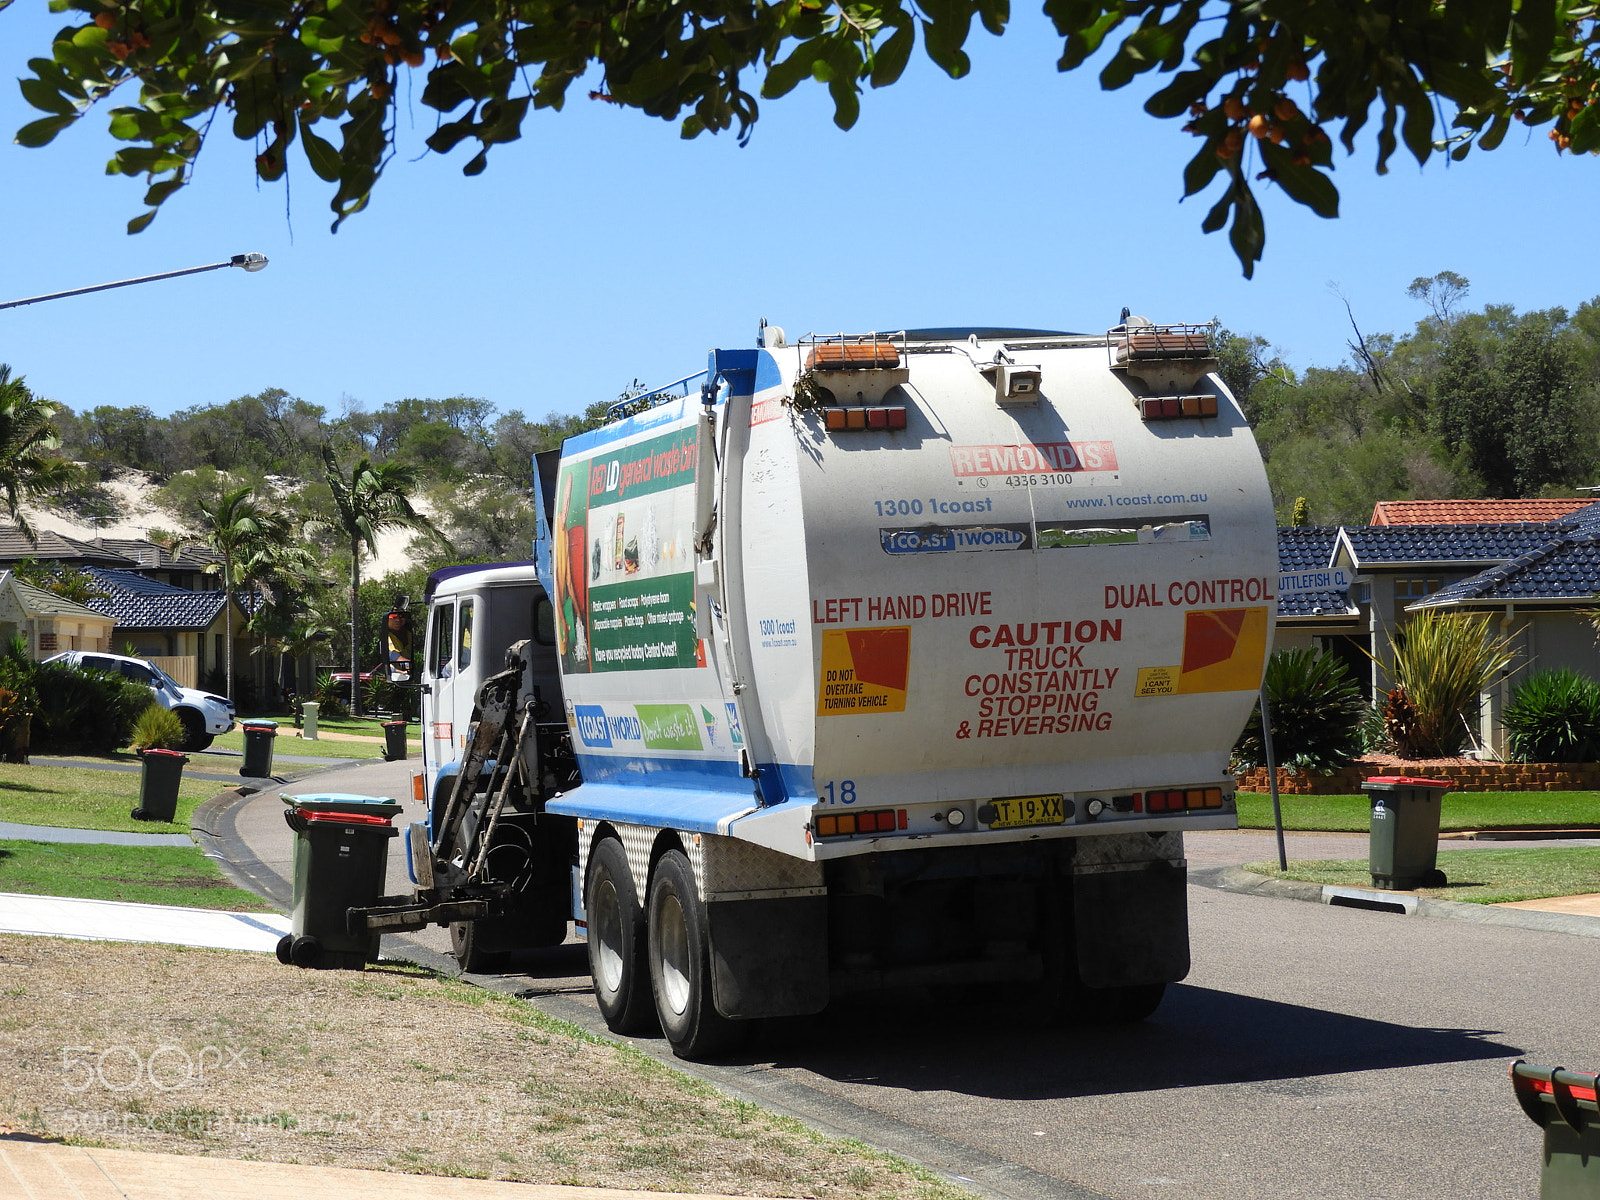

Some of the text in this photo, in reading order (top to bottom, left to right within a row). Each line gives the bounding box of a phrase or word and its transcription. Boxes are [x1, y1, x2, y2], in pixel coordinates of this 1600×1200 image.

[590, 438, 695, 496] RED LID general waste bin
[956, 444, 1102, 473] REMONDIS
[1005, 474, 1072, 487] 4336 3100
[874, 497, 992, 516] 1300 1coast
[1066, 494, 1208, 509] www.1coast.com.au
[957, 531, 1024, 546] 1WORLD
[1279, 571, 1348, 590] UTTLEFISH CL
[1104, 577, 1275, 609] DUAL CONTROL
[813, 591, 992, 624] LEFT HAND DRIVE
[760, 619, 796, 636] 1300 1coast
[969, 618, 1122, 648] CAUTION
[1004, 646, 1084, 670] TRUCK
[826, 669, 854, 682] DO NOT
[964, 667, 1119, 697] CONSTANTLY
[826, 683, 864, 696] OVERTAKE
[824, 695, 888, 709] TURNING VEHICLE
[978, 692, 1098, 718] STOPPING
[578, 716, 608, 740] 1COAST
[608, 716, 642, 740] 1WORLD
[642, 716, 662, 742] Don't
[663, 713, 686, 742] waste
[956, 712, 1112, 739] & REVERSING
[824, 780, 857, 805] 18
